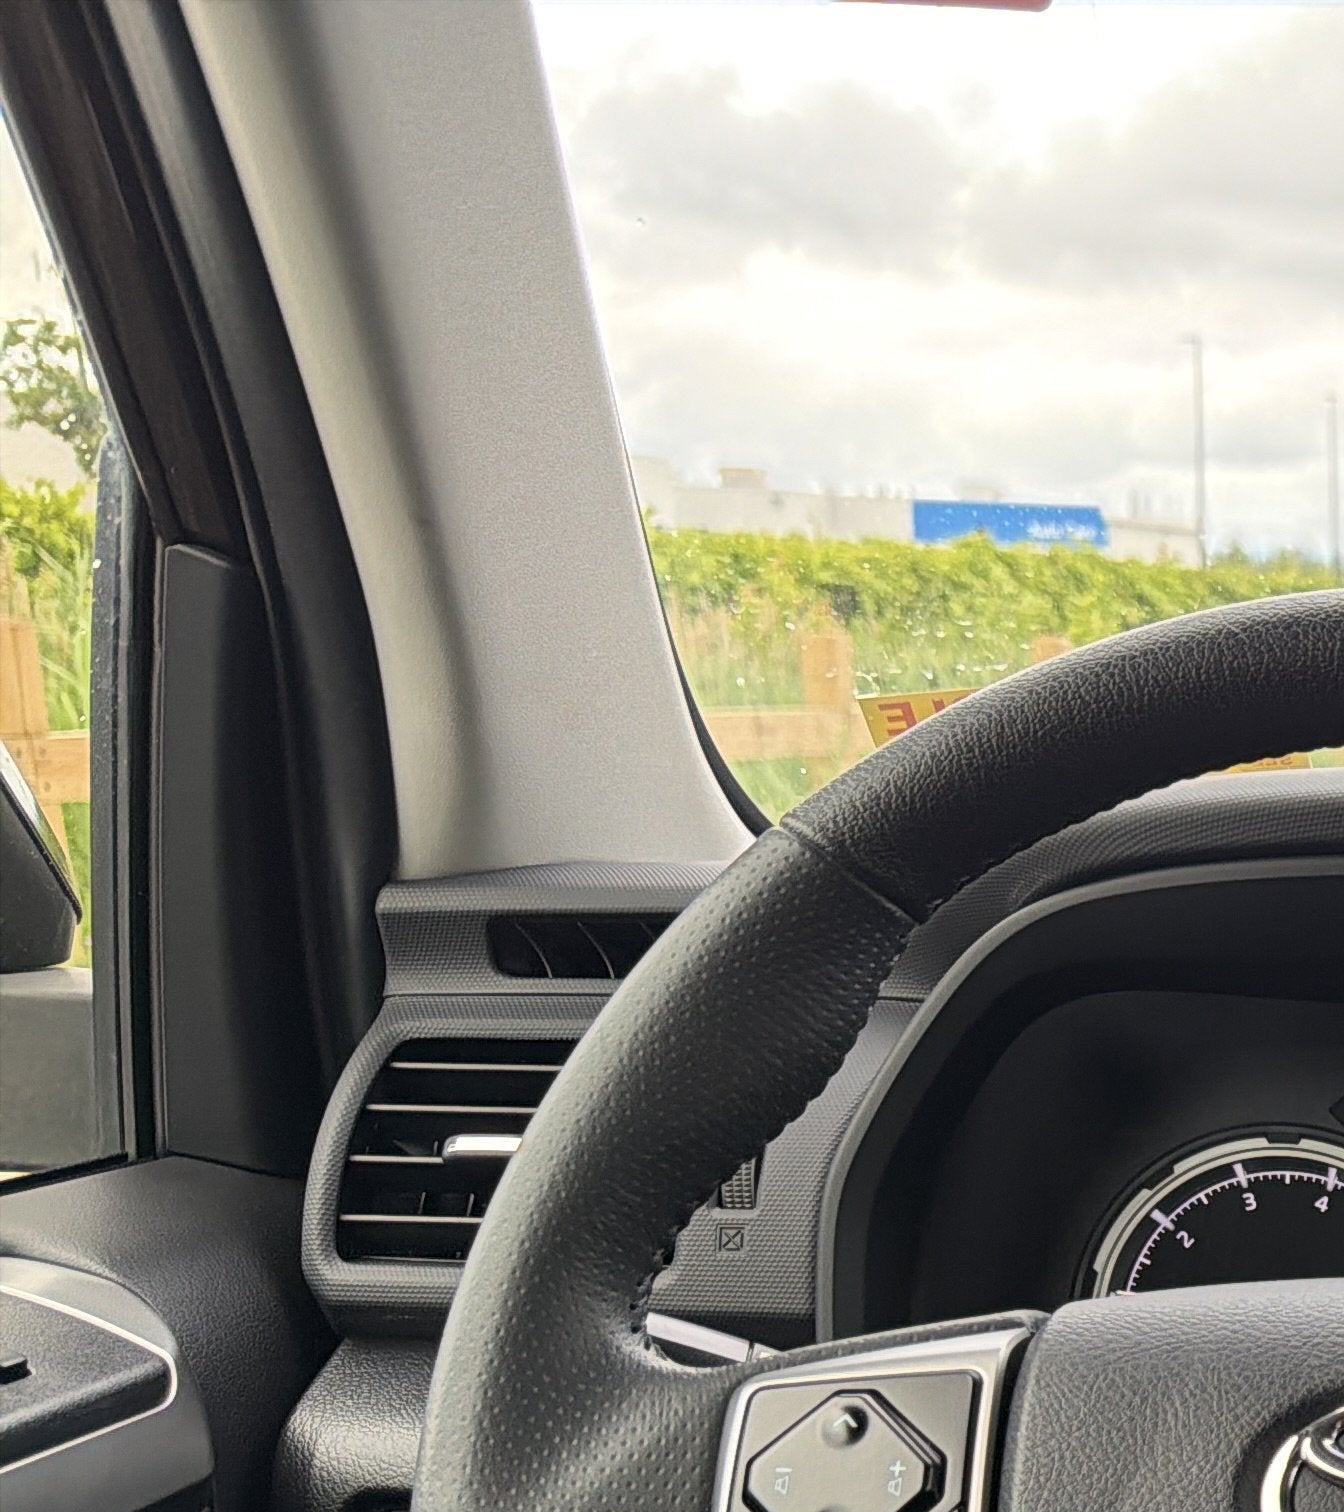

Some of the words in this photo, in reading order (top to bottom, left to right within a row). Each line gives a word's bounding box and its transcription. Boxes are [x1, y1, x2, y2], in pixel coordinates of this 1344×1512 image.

[1243, 1193, 1258, 1211] 3
[1314, 1195, 1329, 1212] 4
[1175, 1230, 1196, 1250] 2
